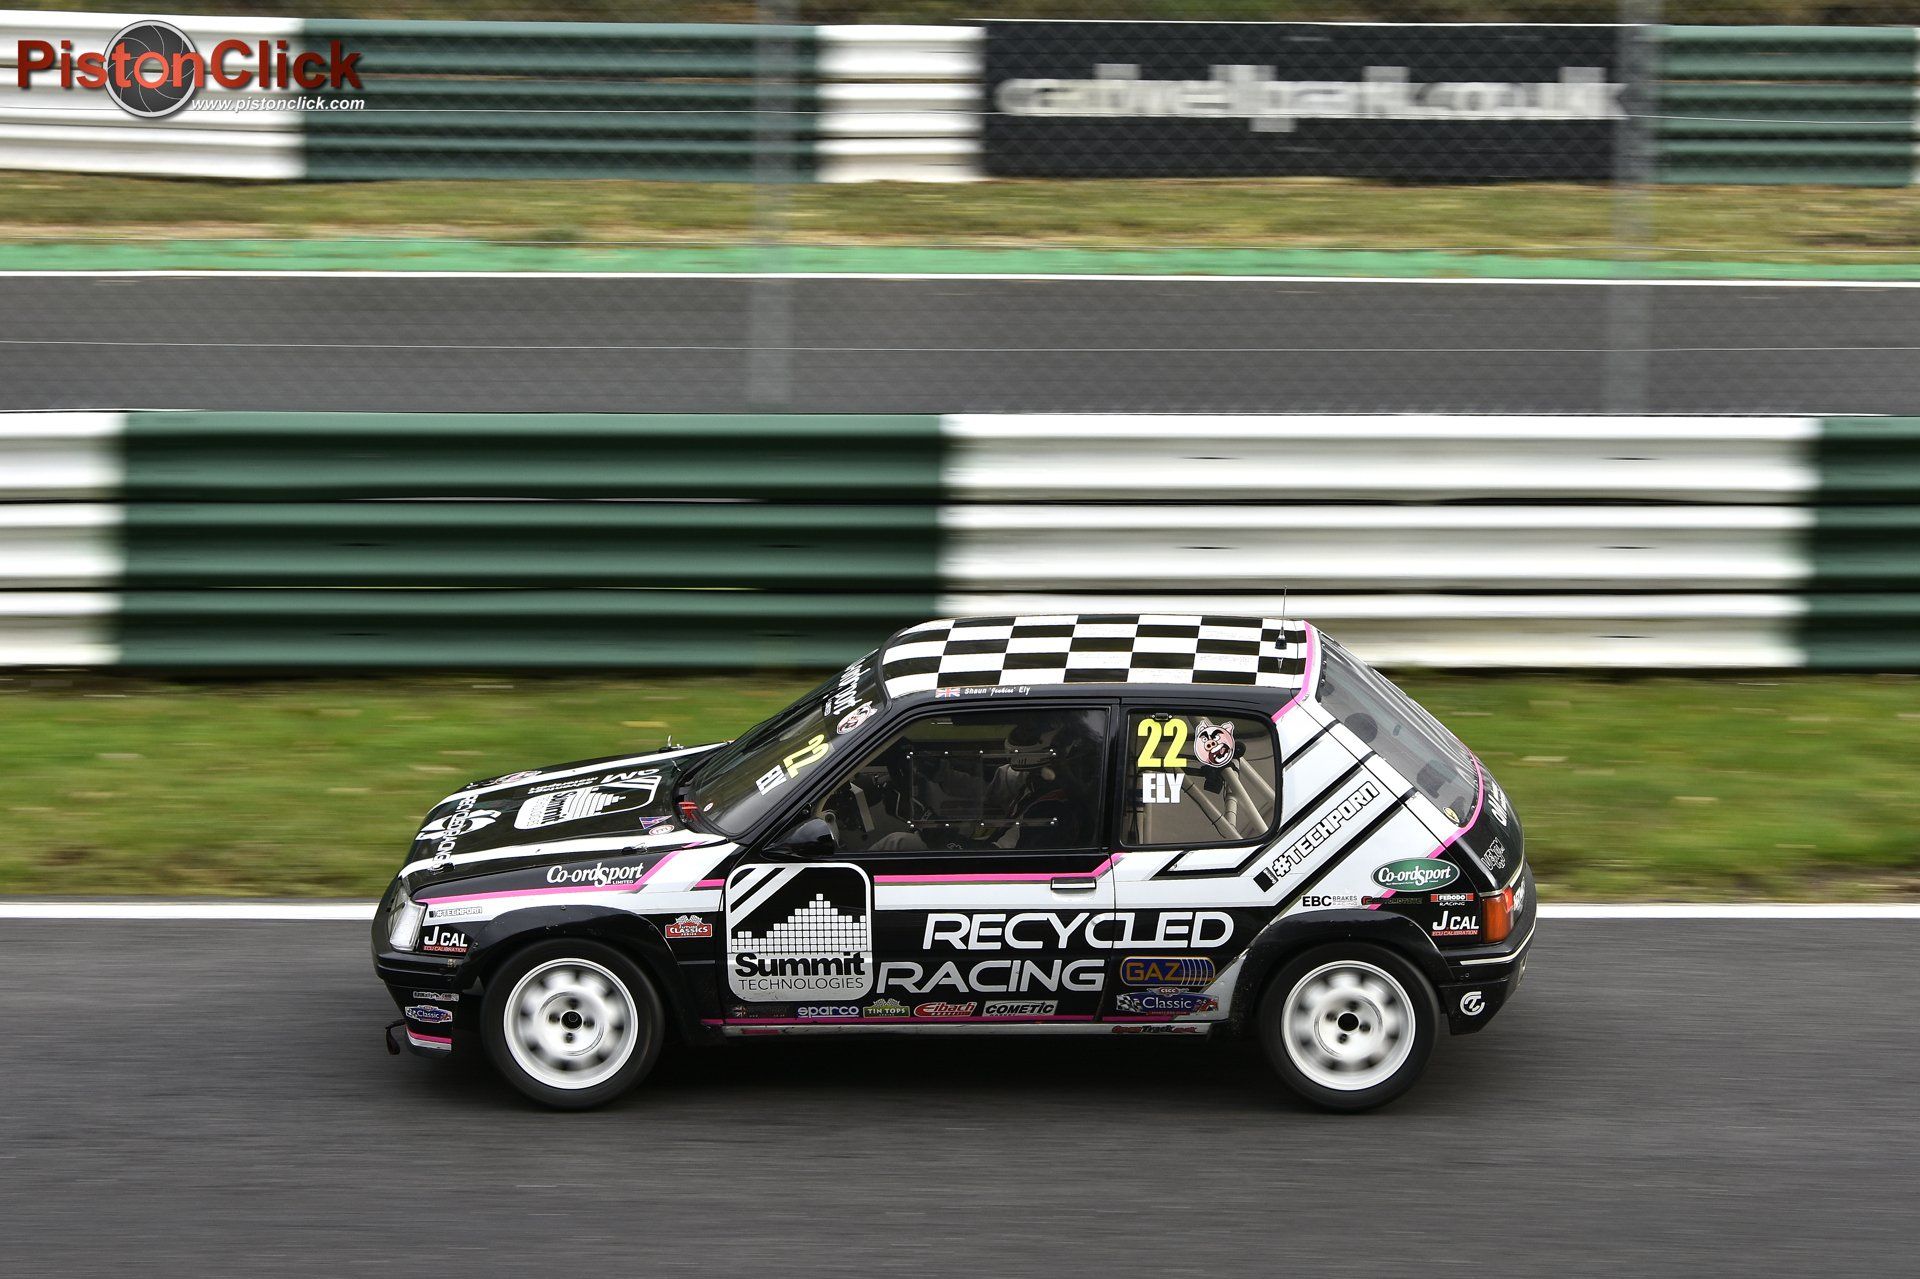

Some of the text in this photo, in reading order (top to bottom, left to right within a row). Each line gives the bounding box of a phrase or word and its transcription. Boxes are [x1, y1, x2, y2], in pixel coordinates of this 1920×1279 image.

[1137, 718, 1188, 768] 22
[783, 733, 830, 779] 22
[1142, 773, 1185, 804] ELY
[1302, 895, 1332, 906] EBC
[669, 926, 708, 934] CLASSICS
[922, 911, 1235, 950] RECYCLED
[735, 951, 866, 977] Summit
[876, 959, 1105, 994] RACING
[1126, 962, 1182, 981] GAZ
[738, 977, 864, 991] TECHNOLOGIES
[915, 1002, 976, 1014] Eibach
[985, 1002, 1055, 1014] COMETIC
[1142, 996, 1192, 1009] Classic
[416, 1010, 440, 1019] Classic
[798, 1006, 859, 1018] sparco
